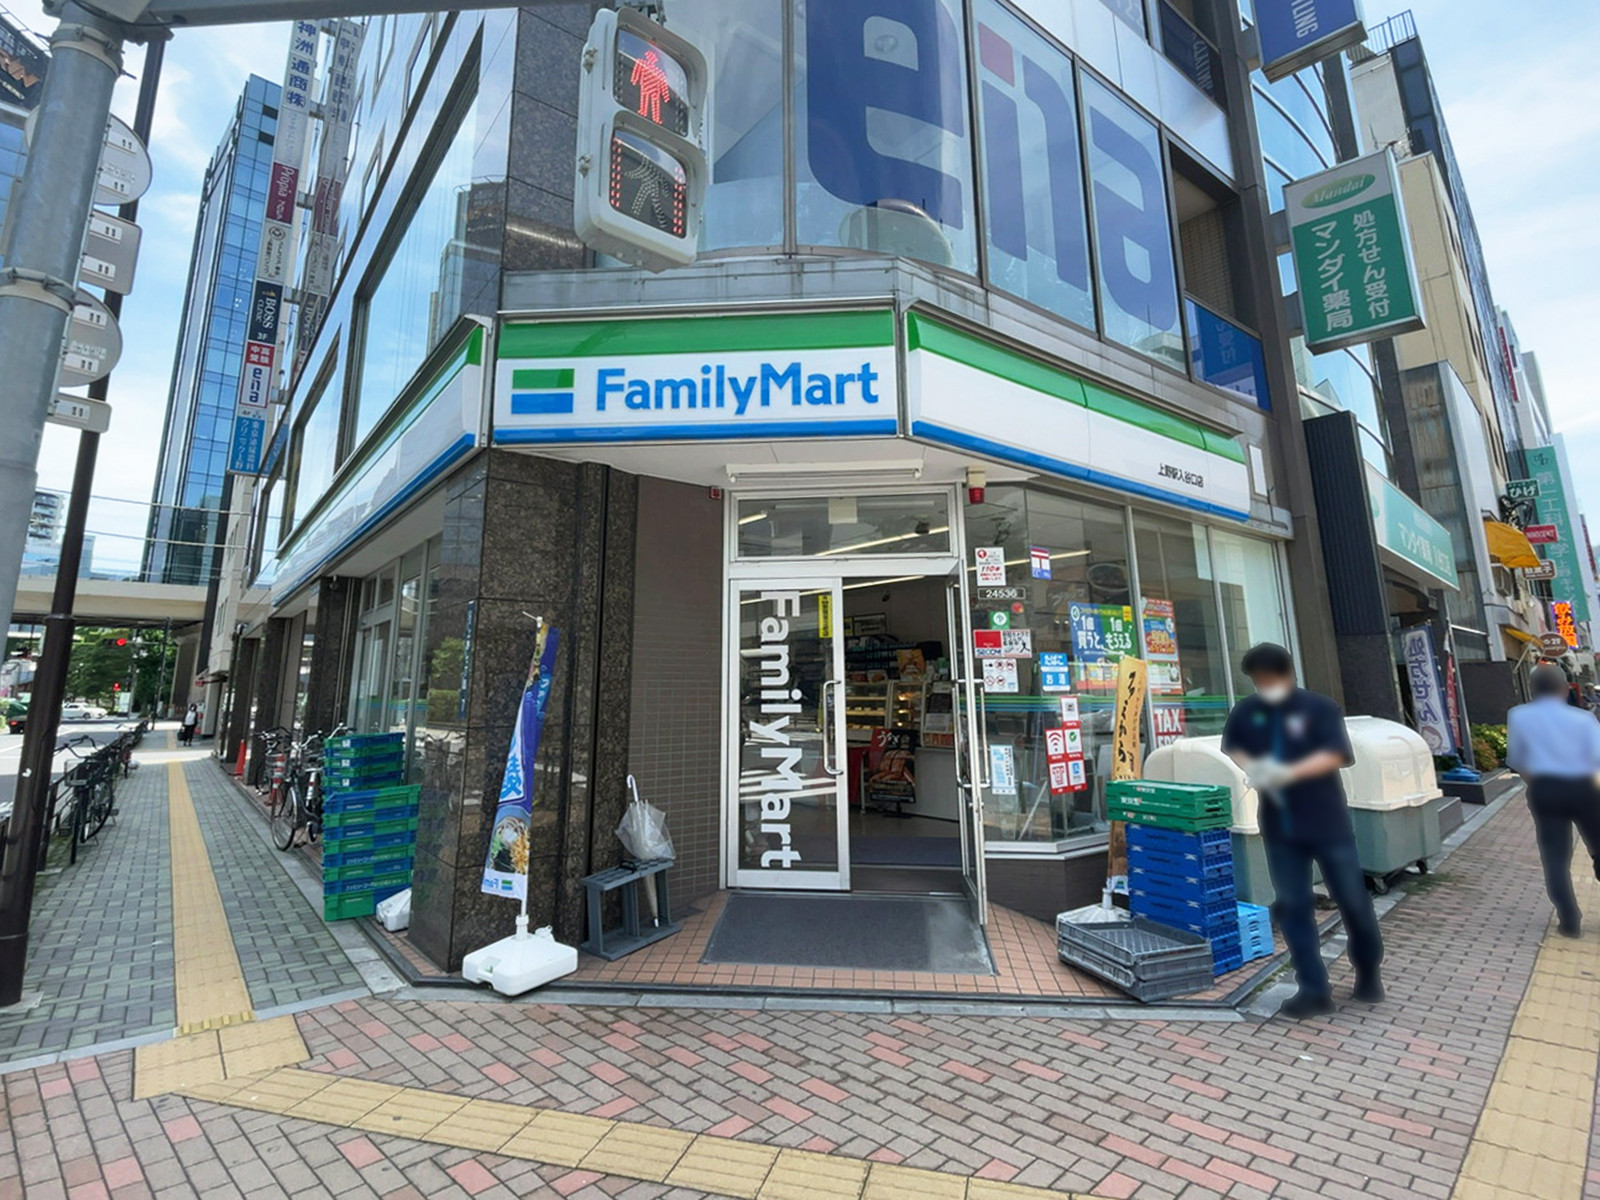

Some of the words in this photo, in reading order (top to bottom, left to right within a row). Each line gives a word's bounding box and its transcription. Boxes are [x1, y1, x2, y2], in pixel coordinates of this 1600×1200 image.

[1312, 220, 1354, 332] マンダイ薬局
[1352, 209, 1390, 319] 処方せん受付
[262, 298, 277, 329] BOSS
[249, 368, 262, 403] ena
[596, 362, 879, 415] FamilyMart
[986, 589, 1017, 598] 24536
[1105, 631, 1132, 650] もらえる
[1044, 655, 1064, 666] たばこ
[749, 590, 803, 869] FamilyMart
[1156, 708, 1182, 733] TAX
